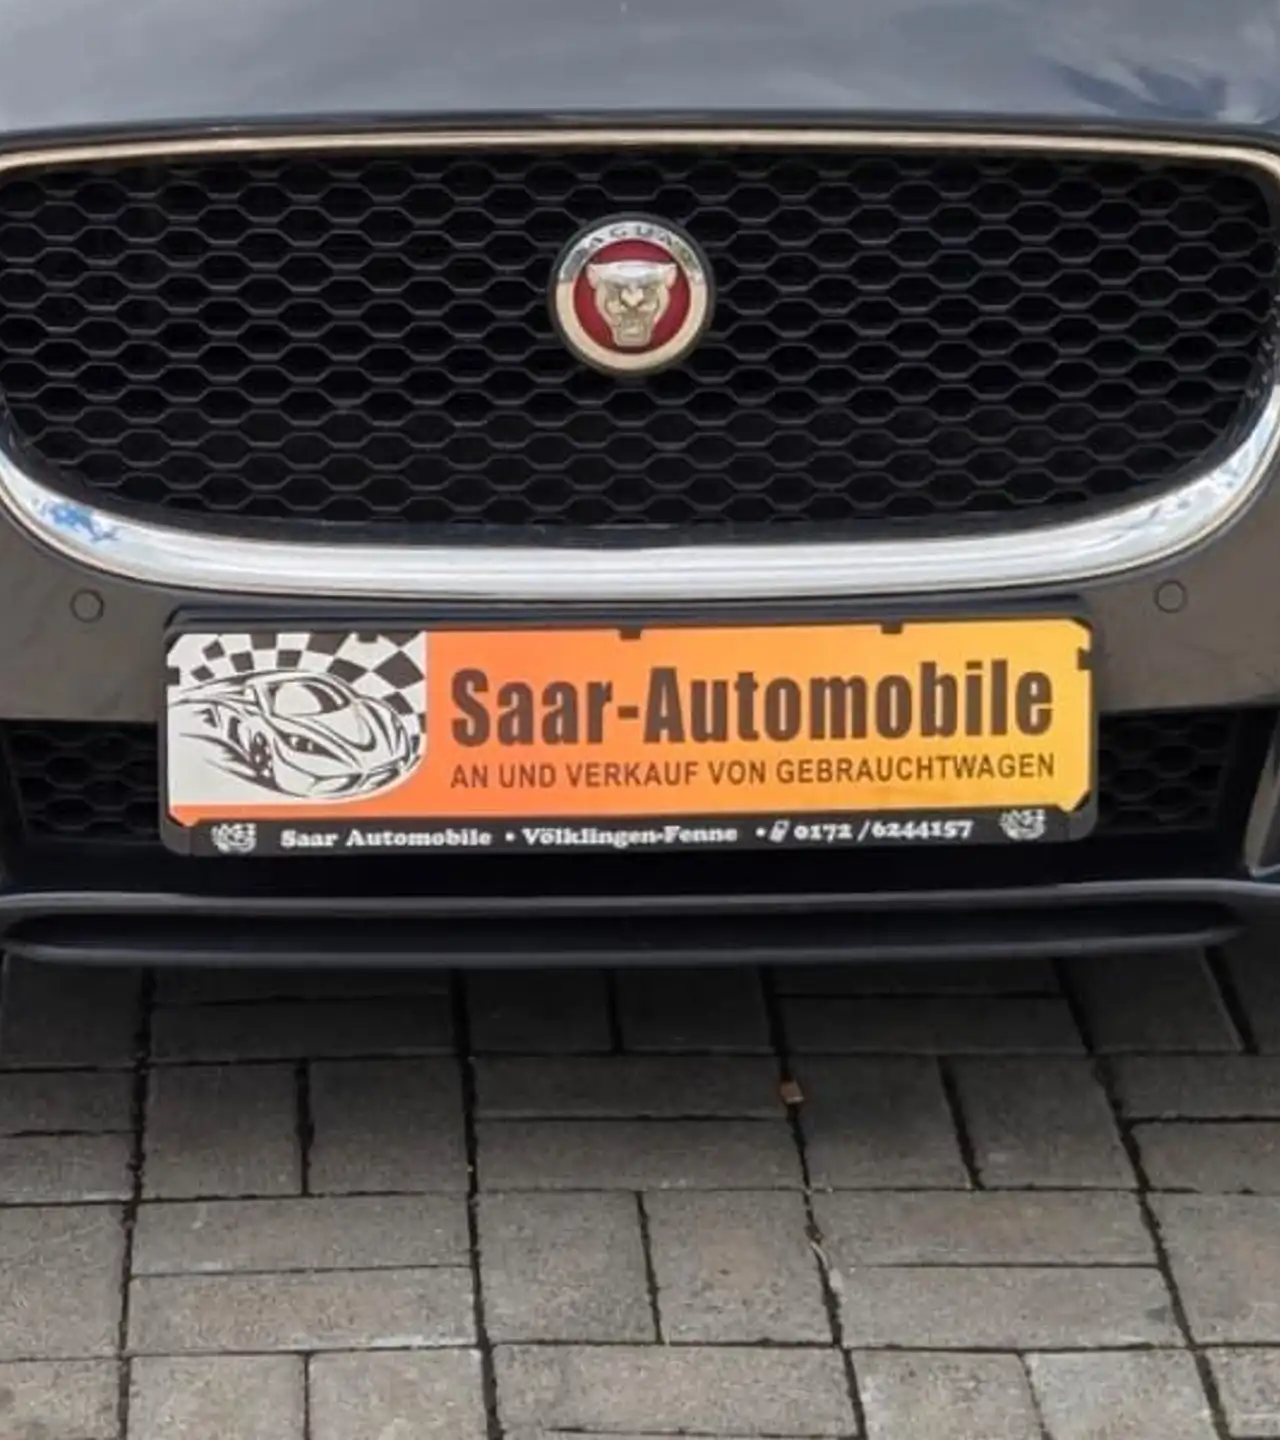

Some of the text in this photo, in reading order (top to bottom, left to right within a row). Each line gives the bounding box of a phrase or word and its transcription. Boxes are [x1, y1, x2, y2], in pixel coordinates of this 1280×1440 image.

[451, 658, 1053, 747] Saar-Automobile
[451, 752, 1055, 789] AN UND VERKAUF VON GEBRAUCHTWAGEN
[280, 829, 338, 849] Saar
[345, 827, 493, 849] Automobile
[522, 825, 739, 849] Völklingen-Fenne
[794, 822, 853, 841] 0172
